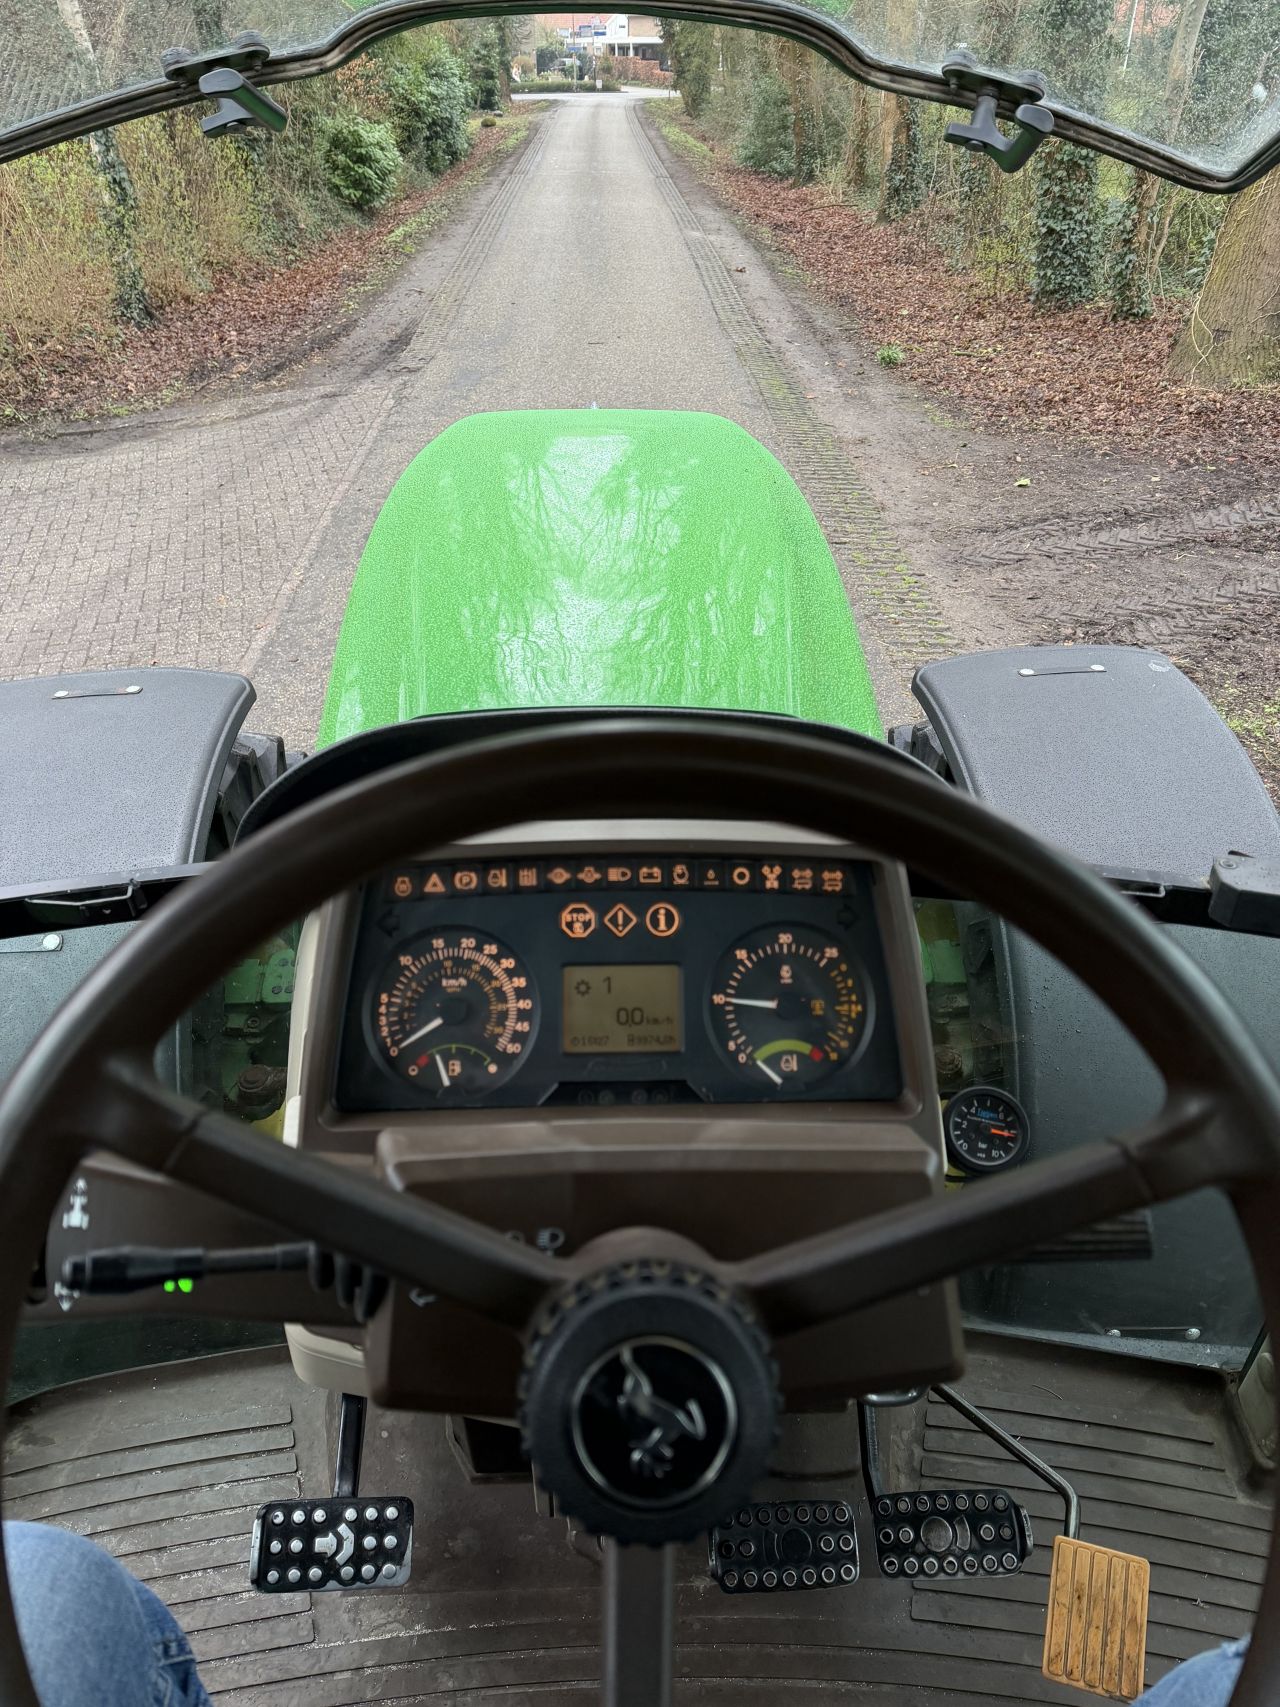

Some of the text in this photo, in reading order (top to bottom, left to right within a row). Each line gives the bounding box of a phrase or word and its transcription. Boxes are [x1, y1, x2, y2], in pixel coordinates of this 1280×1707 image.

[565, 912, 592, 922] STOP
[431, 937, 446, 949] 15
[460, 937, 476, 949] 20
[778, 932, 793, 944] 20
[482, 943, 498, 955] 25
[735, 949, 748, 960] 15
[823, 946, 839, 958] 25
[399, 955, 413, 966] 10
[499, 958, 515, 969] 30
[441, 977, 468, 987] km/h
[511, 976, 527, 988] 35
[602, 975, 612, 995] 1
[380, 992, 389, 1004] 5
[712, 994, 726, 1005] 10
[378, 1004, 388, 1014] 4
[517, 999, 532, 1010] 40
[379, 1015, 388, 1026] 3
[380, 1026, 389, 1037] 2
[513, 1021, 530, 1032] 45
[385, 1037, 392, 1048] 1
[727, 1040, 736, 1051] 5
[390, 1046, 399, 1057] 0
[506, 1043, 522, 1054] 50
[738, 1052, 747, 1064] 0
[978, 1141, 987, 1149] bar
[992, 1149, 999, 1158] 10
